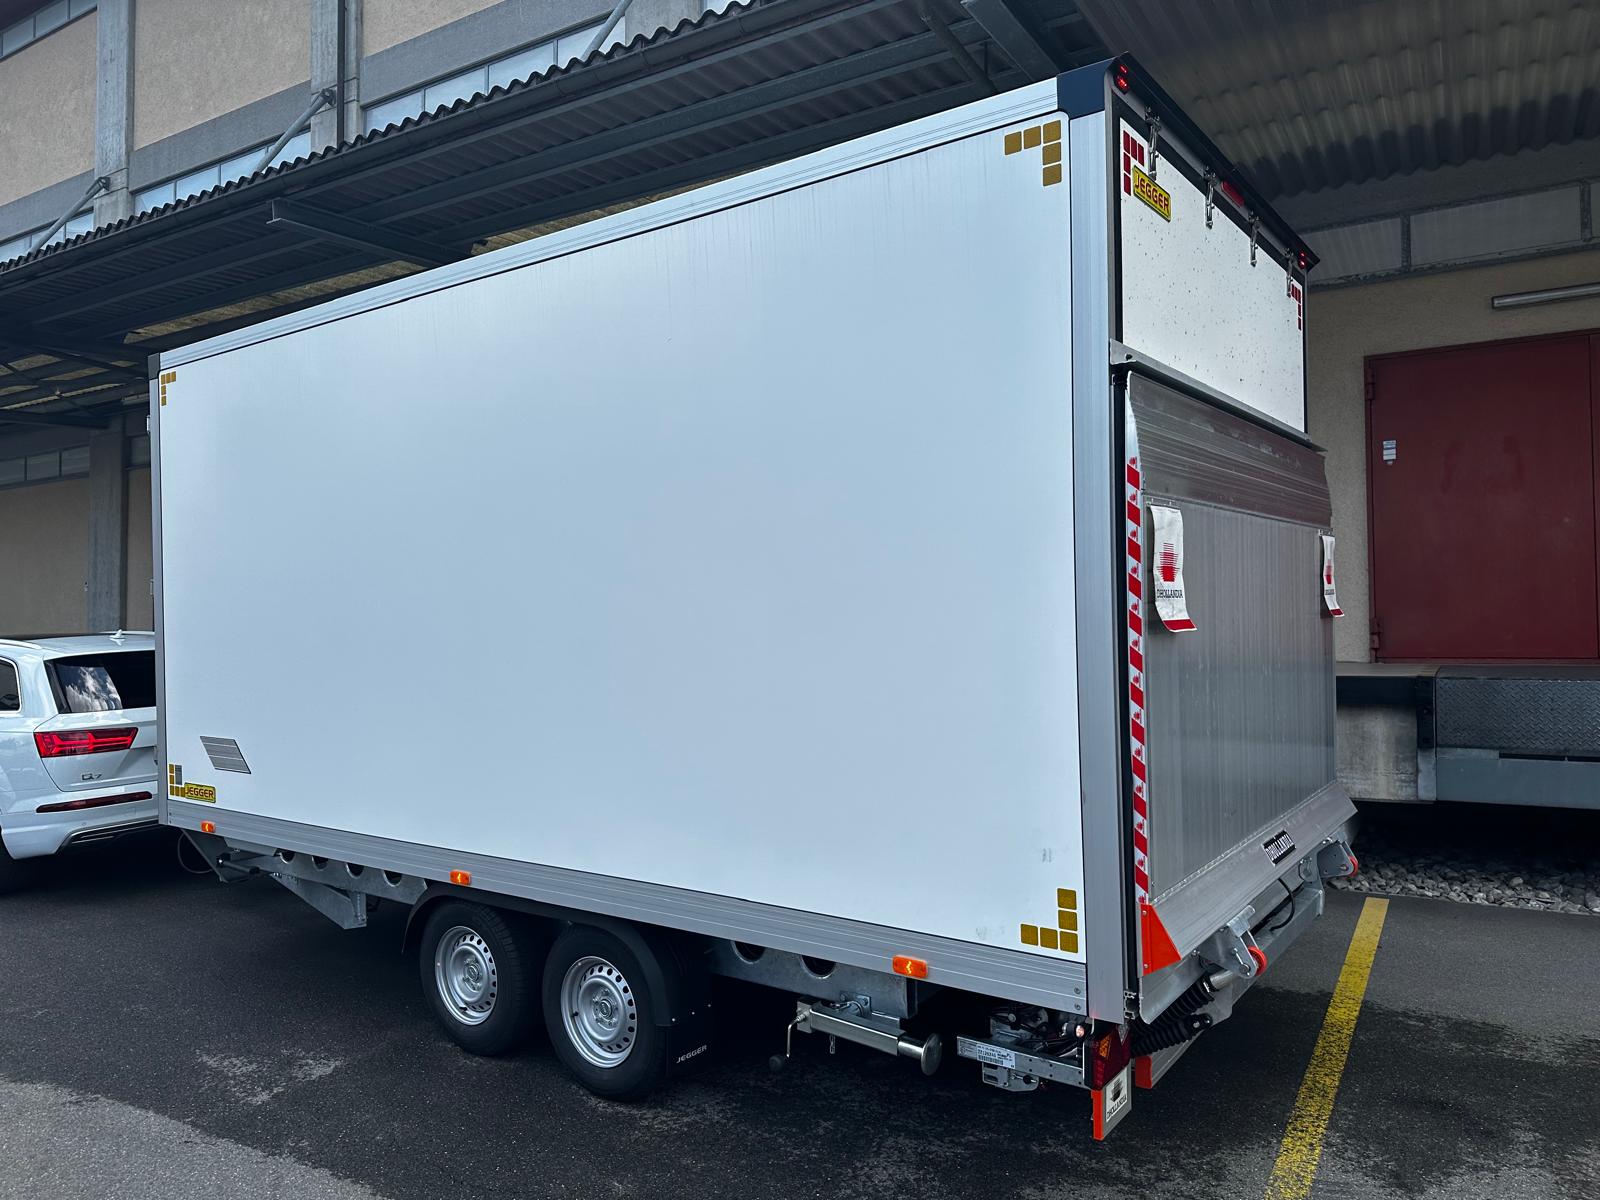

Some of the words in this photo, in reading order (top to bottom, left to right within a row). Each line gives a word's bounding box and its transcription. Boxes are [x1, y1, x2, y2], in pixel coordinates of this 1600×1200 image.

[1135, 172, 1169, 215] JEGGER
[186, 786, 213, 798] JEGGER
[676, 1045, 707, 1063] JEGGER
